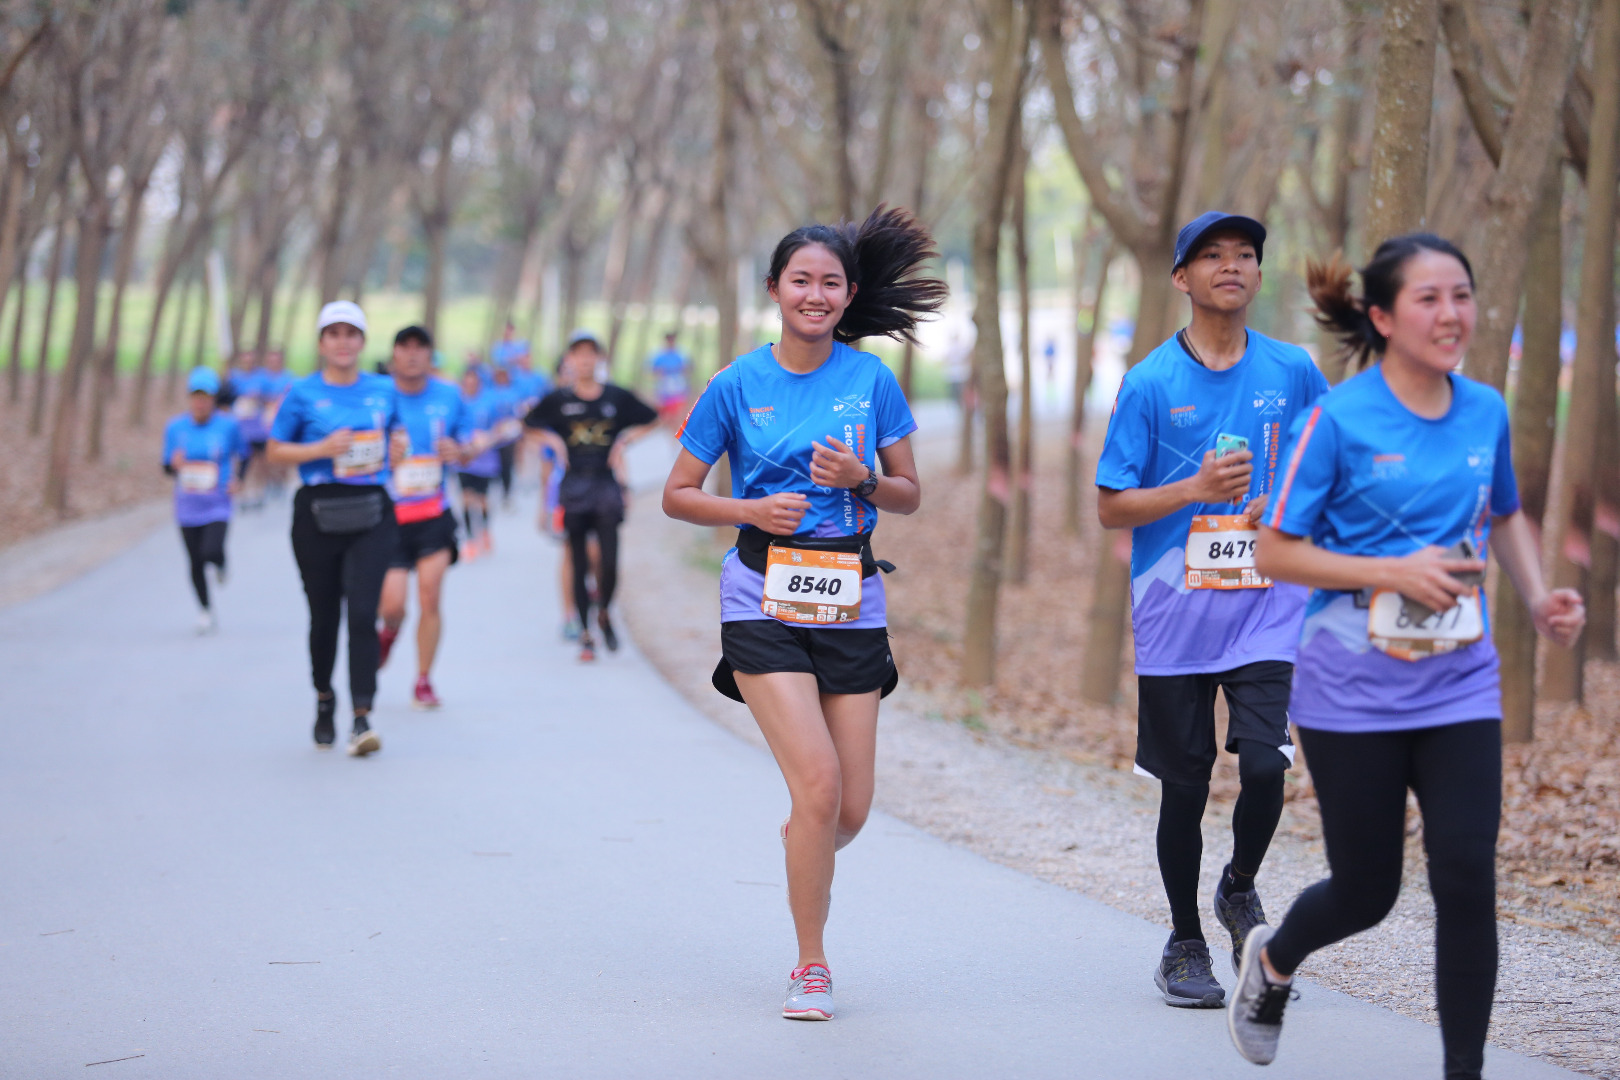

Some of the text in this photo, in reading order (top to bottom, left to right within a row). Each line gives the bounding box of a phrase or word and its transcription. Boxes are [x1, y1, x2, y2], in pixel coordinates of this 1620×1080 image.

[748, 405, 774, 414] SINGHA
[833, 400, 871, 412] SP XC
[1253, 399, 1264, 408] SP
[856, 423, 866, 462] SINGH
[1268, 422, 1280, 470] SINGHA
[844, 505, 853, 527] RUN
[1208, 539, 1257, 560] 8479
[787, 574, 842, 596] 8540
[839, 612, 848, 622] 8
